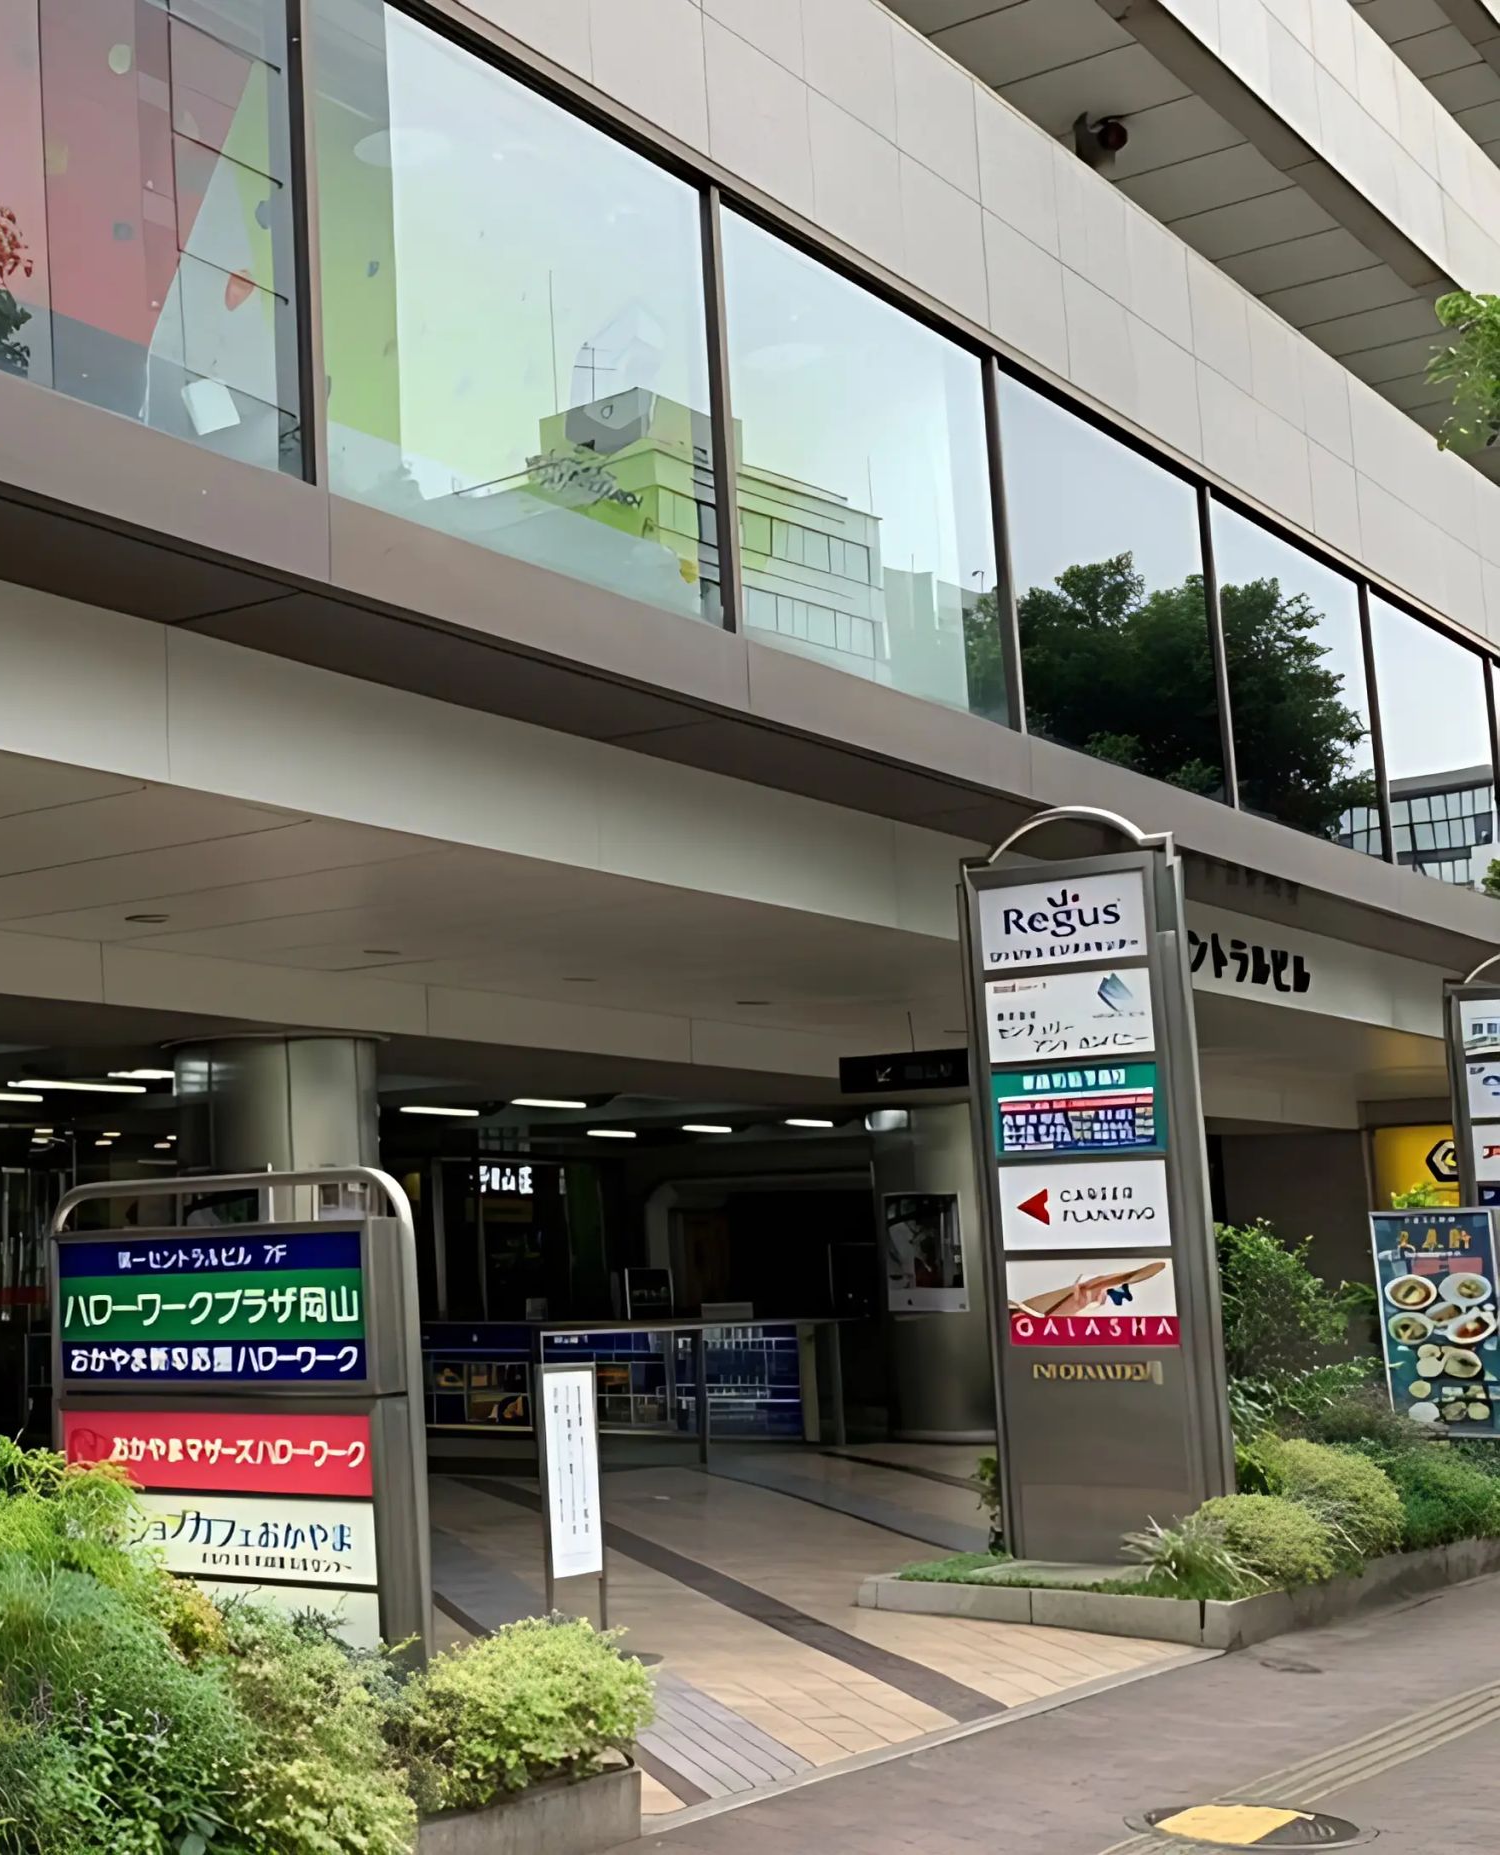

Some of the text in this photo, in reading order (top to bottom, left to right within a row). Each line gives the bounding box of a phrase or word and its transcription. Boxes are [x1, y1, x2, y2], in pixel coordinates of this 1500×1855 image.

[1003, 903, 1121, 938] Regus
[64, 1285, 359, 1328] ハローワークプラザ岡山
